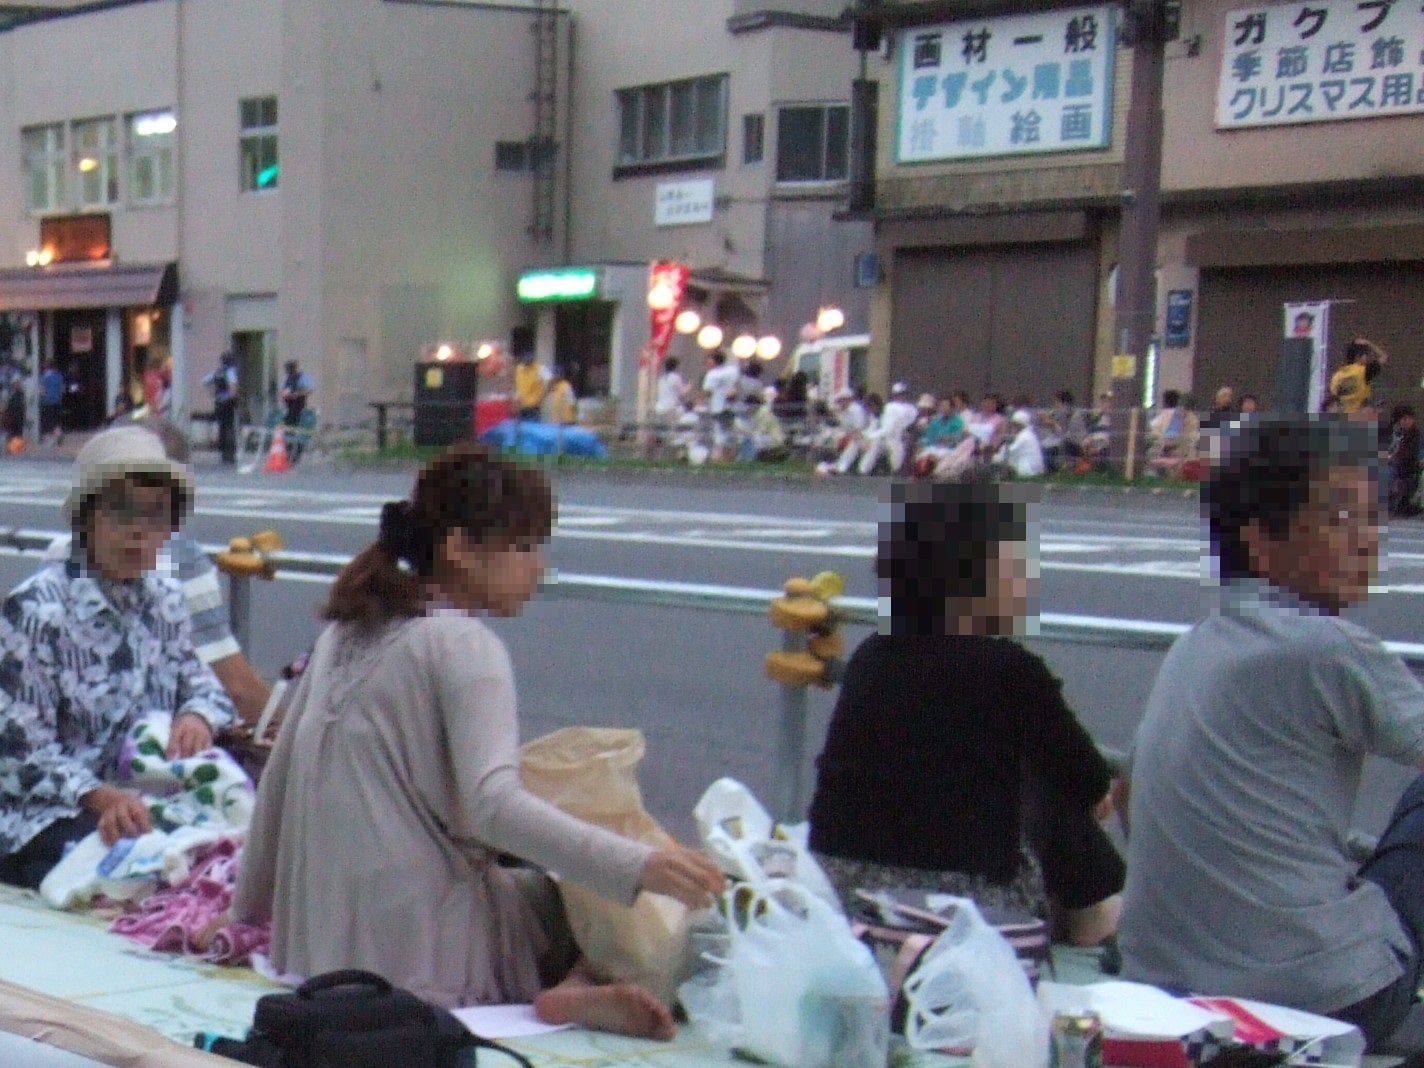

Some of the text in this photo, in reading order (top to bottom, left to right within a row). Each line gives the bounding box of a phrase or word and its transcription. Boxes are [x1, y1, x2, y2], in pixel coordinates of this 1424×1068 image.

[913, 13, 1098, 70] 画材一般
[1232, 35, 1424, 83] 季節店飾
[912, 57, 1095, 111] デザイン用品
